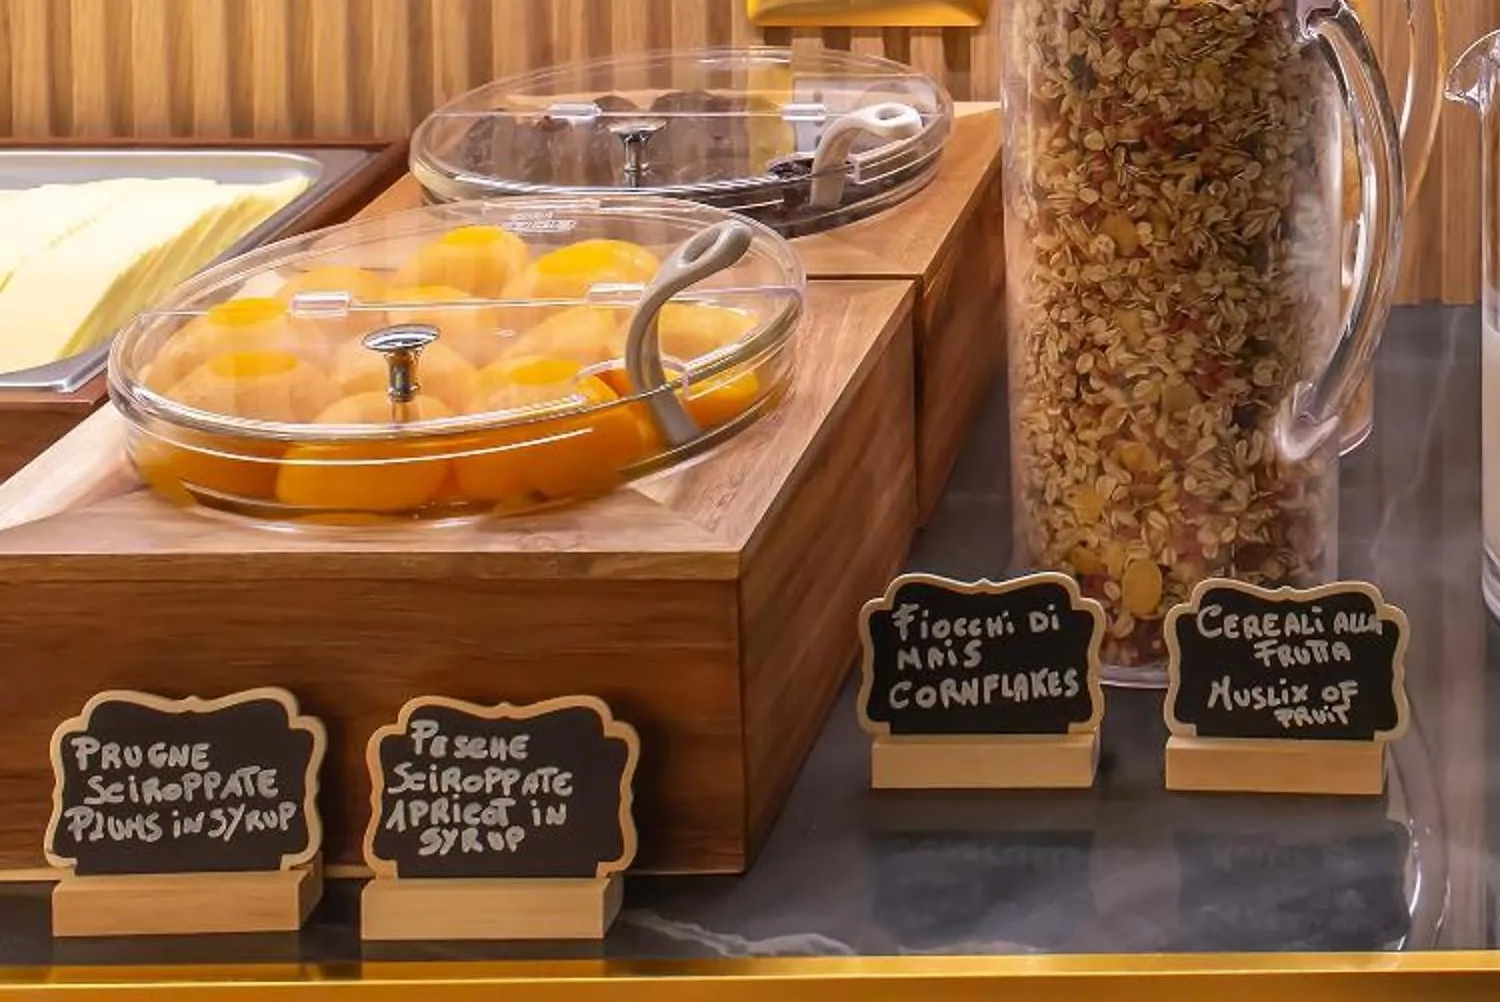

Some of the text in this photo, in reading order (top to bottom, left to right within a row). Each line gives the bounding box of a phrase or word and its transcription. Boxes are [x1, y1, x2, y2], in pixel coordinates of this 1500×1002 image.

[1029, 604, 1060, 633] DI
[1197, 604, 1325, 639] CEREALI
[897, 639, 982, 669] MAIS
[1253, 639, 1351, 667] FRUTTA
[889, 667, 1080, 709] CORNFLAKES
[1321, 680, 1359, 711] OF
[1274, 704, 1350, 728] FRUIT
[70, 736, 210, 771] PRUGNE
[84, 765, 279, 805] SCIROPPATE
[387, 762, 573, 797] SCIROPPATE
[207, 801, 297, 842] SYRUP
[385, 794, 516, 832] APRICOT
[417, 825, 526, 856] SYRUP
